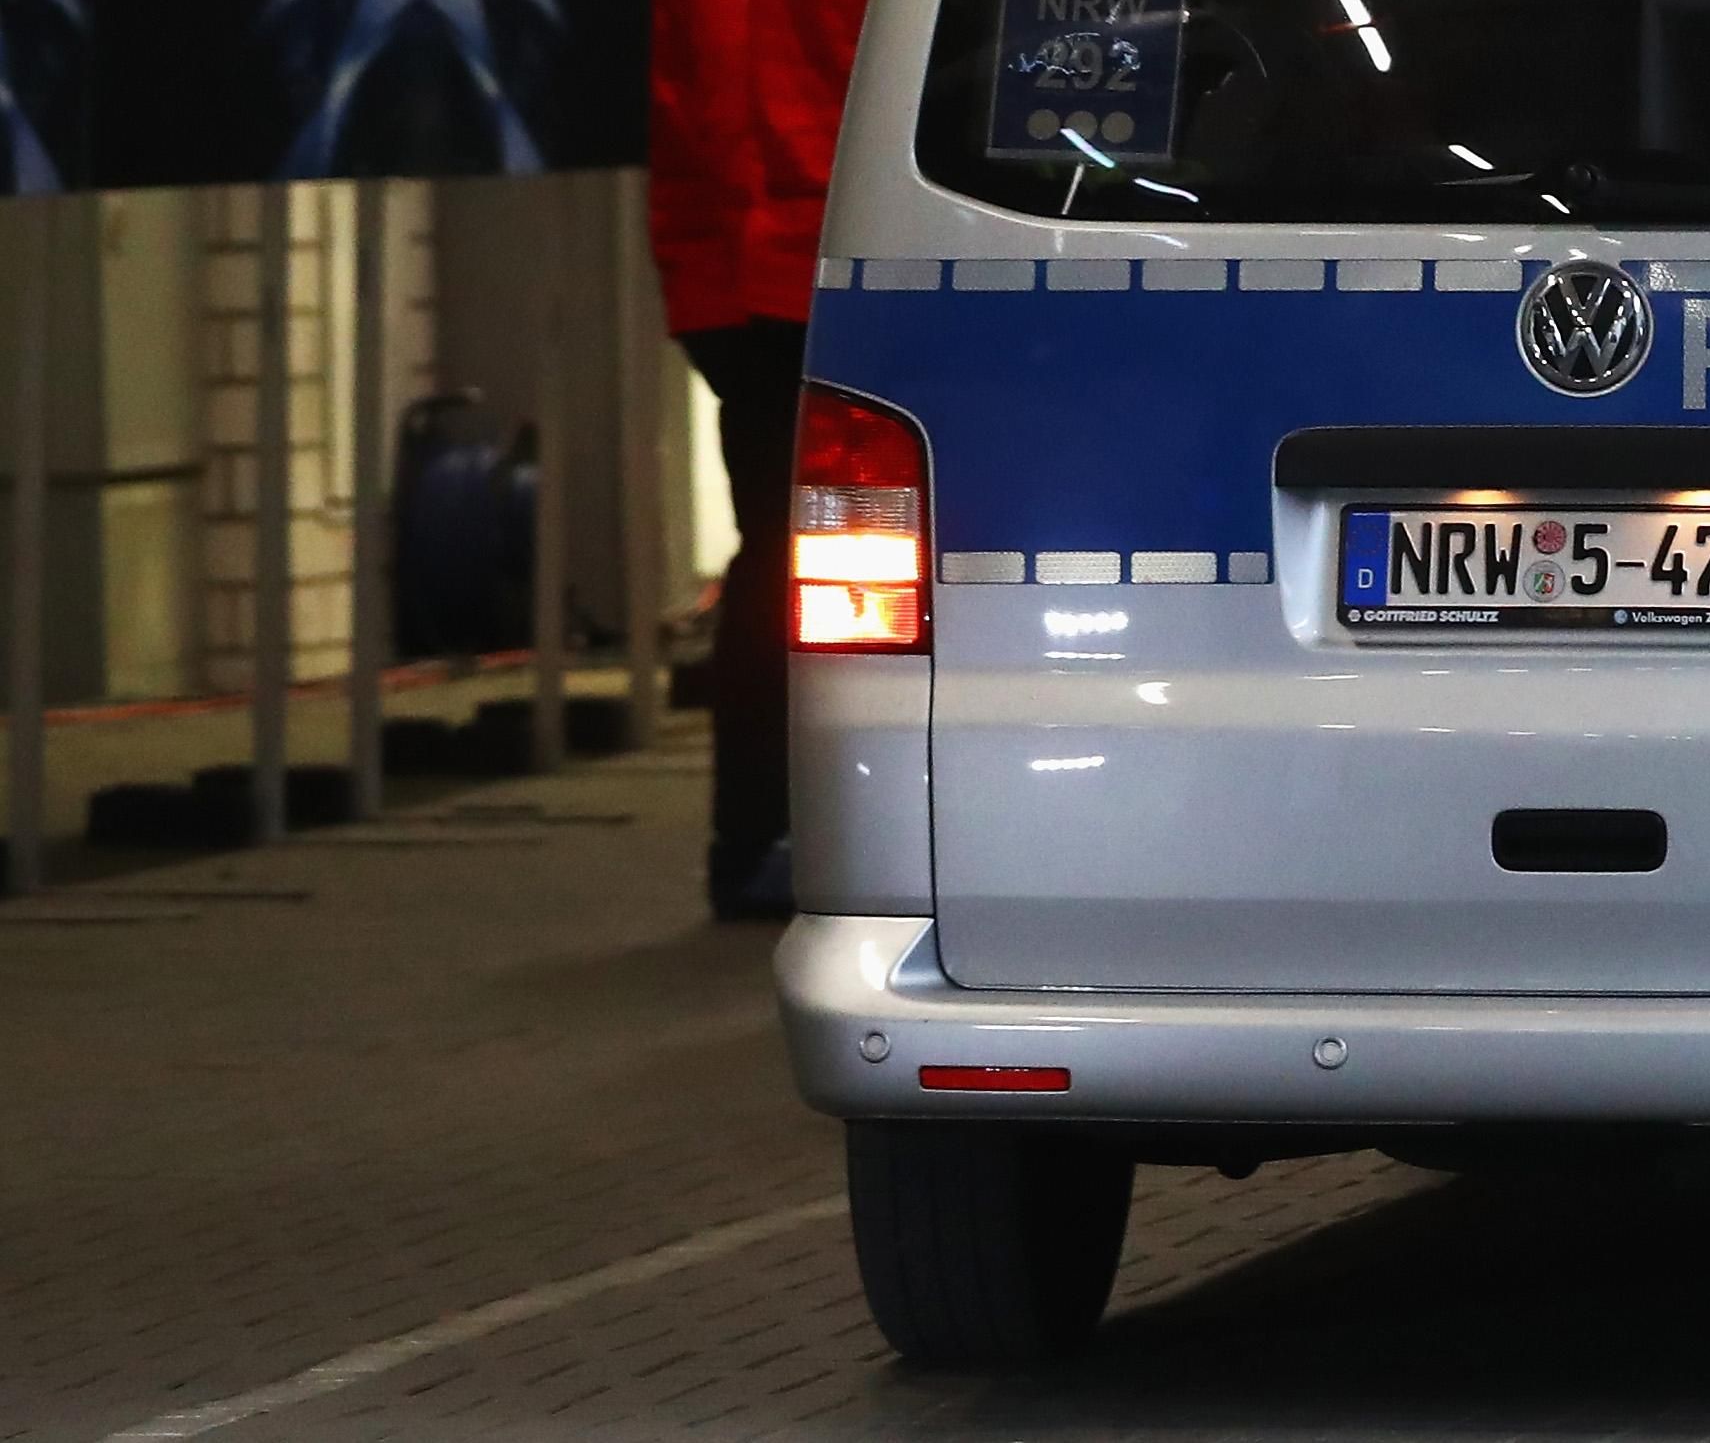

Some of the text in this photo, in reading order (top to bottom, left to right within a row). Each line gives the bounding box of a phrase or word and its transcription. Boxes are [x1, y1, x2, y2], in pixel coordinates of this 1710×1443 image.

[1034, 37, 1142, 92] 292
[1390, 521, 1523, 596] NRW
[1358, 568, 1373, 589] D
[1363, 609, 1500, 623] GOTTFRIED SCHULTZ
[1632, 611, 1703, 626] Volkswagen
